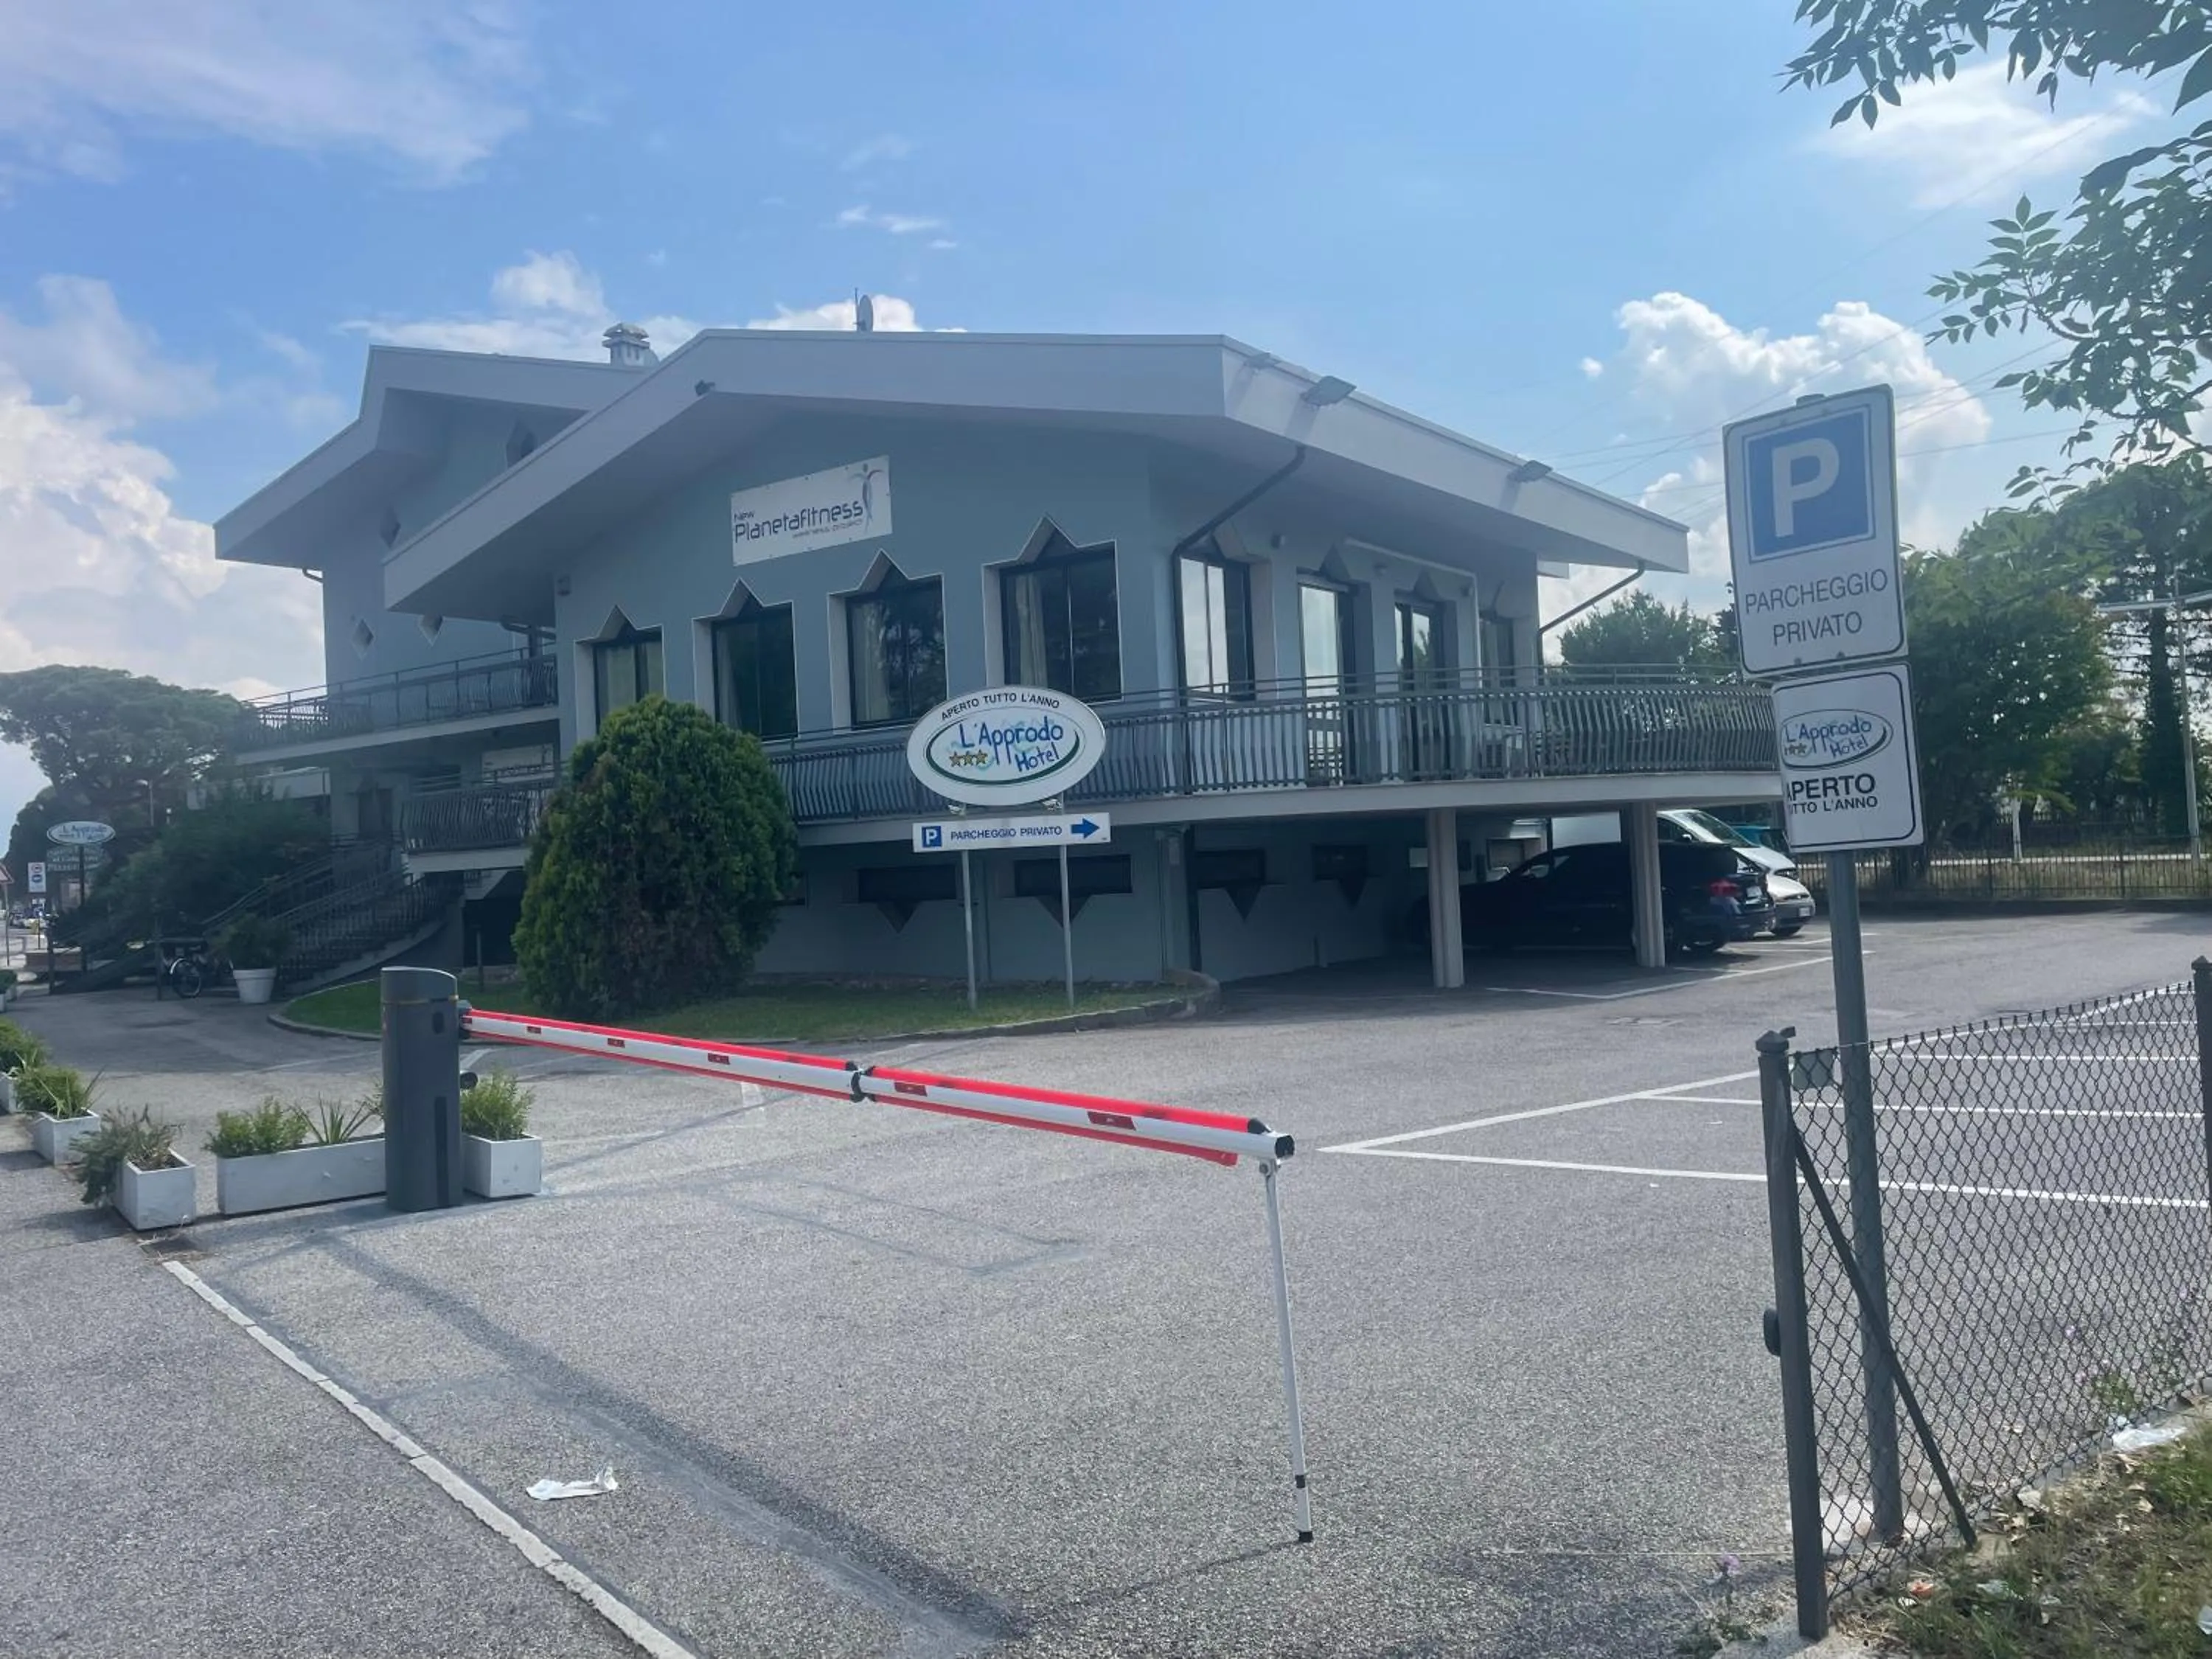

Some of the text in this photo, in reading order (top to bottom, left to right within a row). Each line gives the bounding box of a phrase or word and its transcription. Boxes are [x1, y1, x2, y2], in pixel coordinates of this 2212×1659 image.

[1772, 437, 1840, 538] P
[735, 501, 863, 543] Planetafitness
[1745, 568, 1888, 614] PARCHEGGIO
[1773, 611, 1863, 646] PRIVATO
[941, 692, 1060, 721] APERTO TUTTO L'ANNO
[959, 715, 1063, 765] L'Approdo
[1784, 714, 1872, 754] L'Approdo
[1830, 734, 1869, 759] Hotel
[1014, 742, 1060, 772] Hotel
[1823, 796, 1879, 812] L'ANNO
[925, 825, 1062, 844] P PARCHEGGIO PRIVATO
